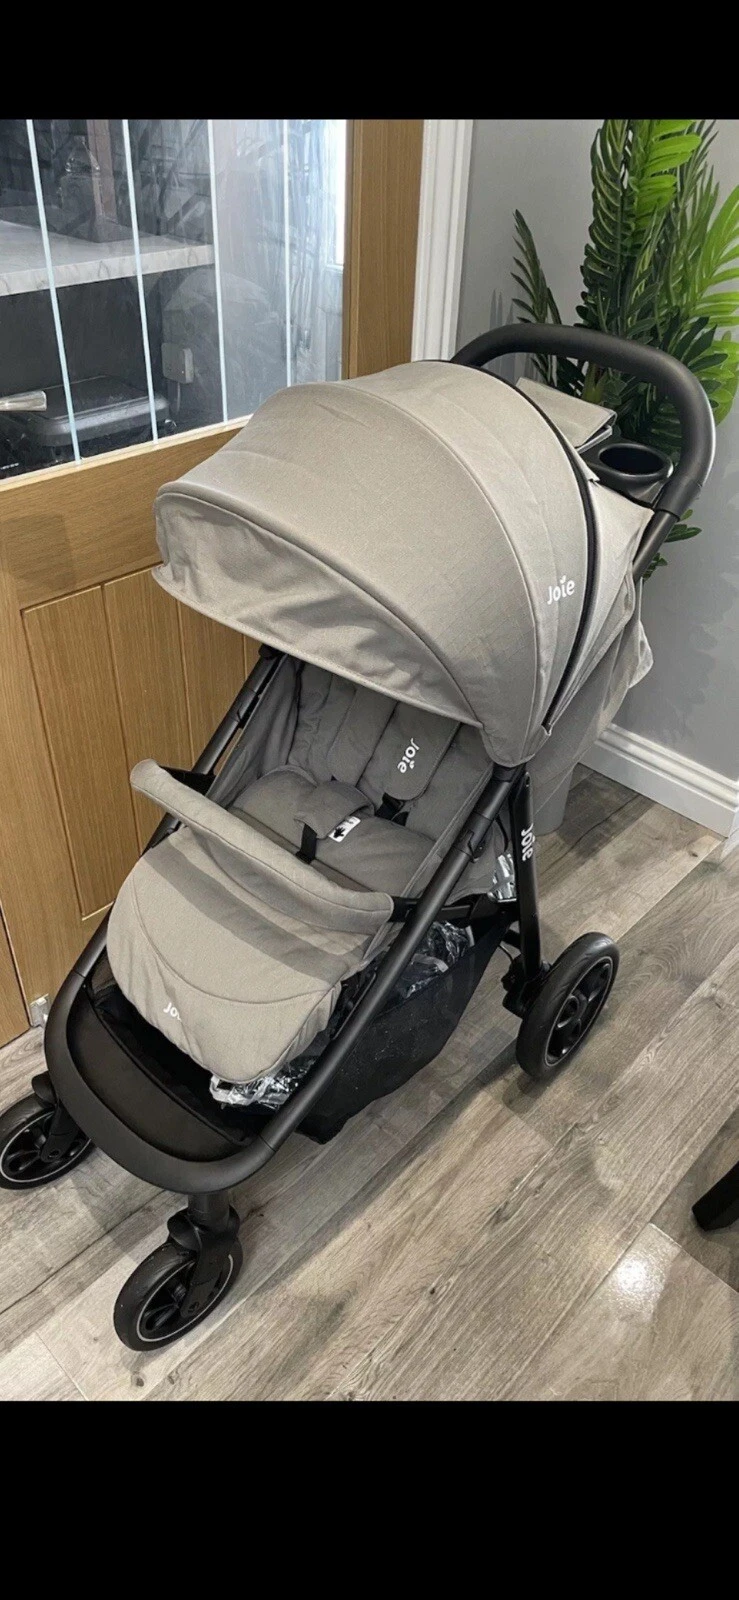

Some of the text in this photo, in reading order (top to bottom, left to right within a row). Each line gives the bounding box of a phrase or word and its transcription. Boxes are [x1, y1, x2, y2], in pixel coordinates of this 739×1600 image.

[547, 575, 575, 605] Joie
[397, 737, 420, 773] Joie
[521, 822, 536, 861] Joie
